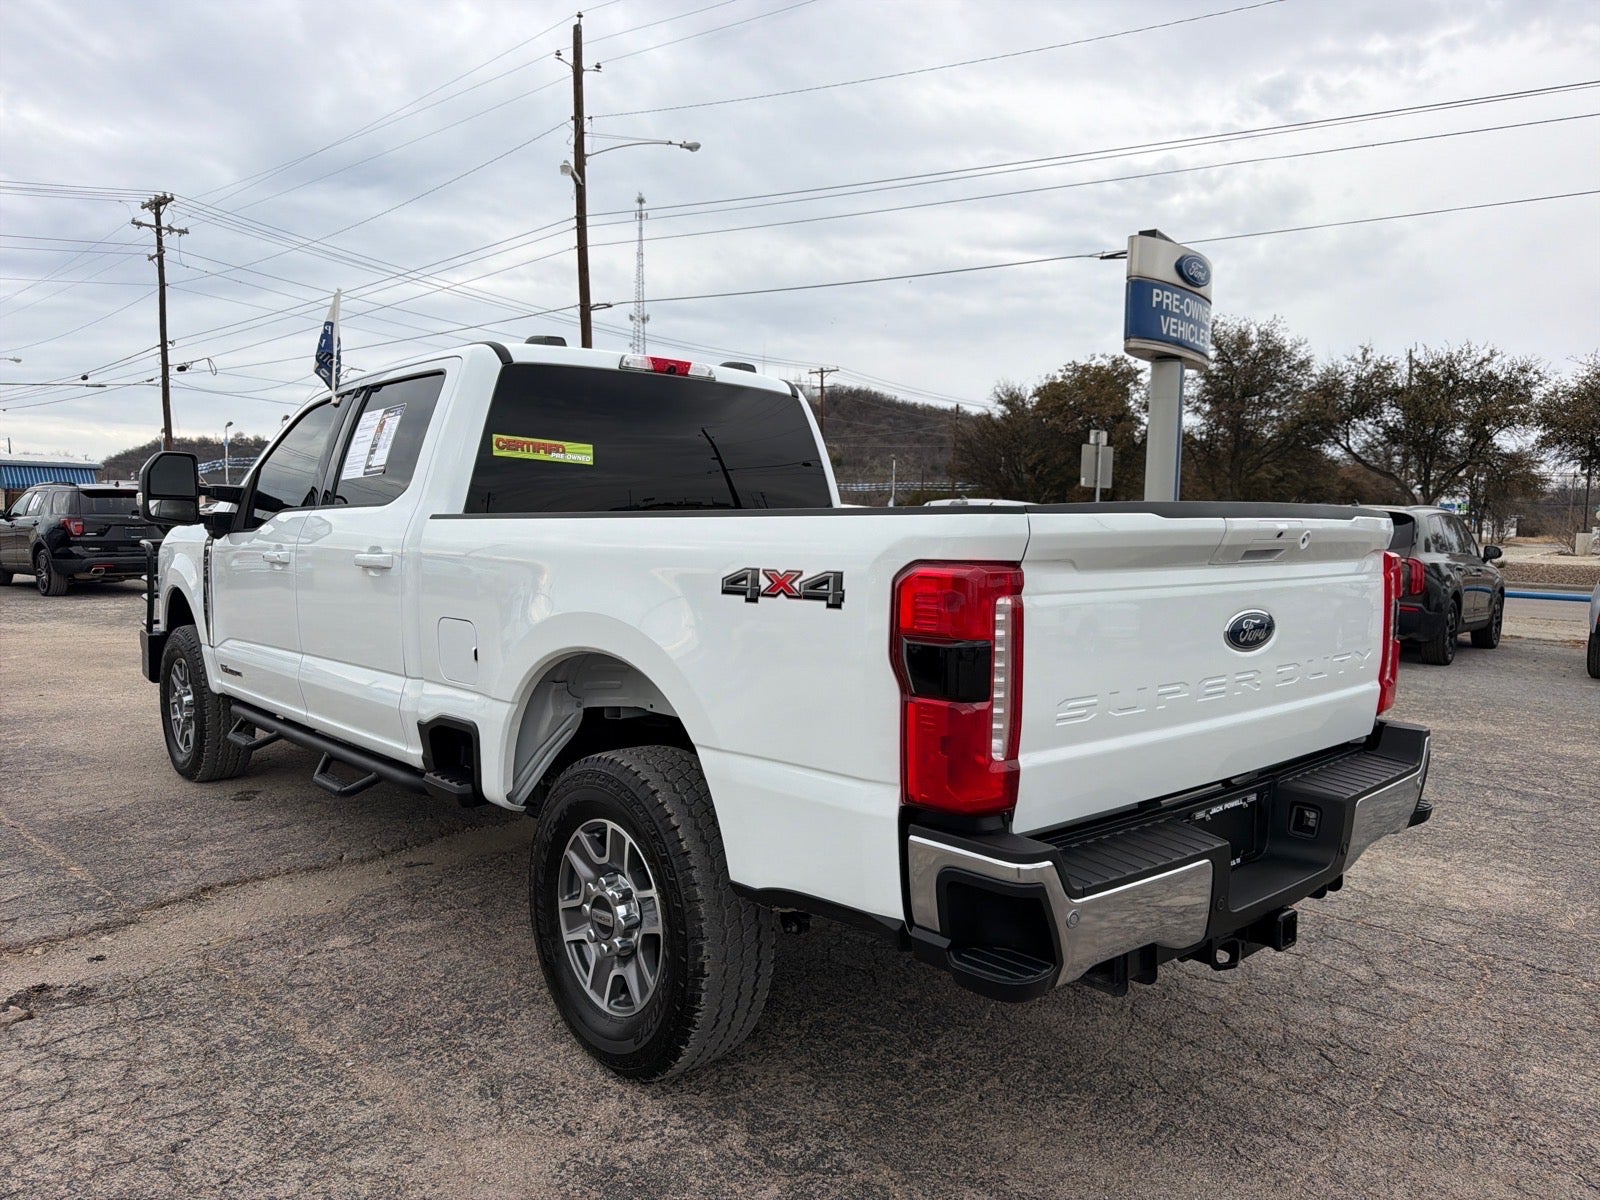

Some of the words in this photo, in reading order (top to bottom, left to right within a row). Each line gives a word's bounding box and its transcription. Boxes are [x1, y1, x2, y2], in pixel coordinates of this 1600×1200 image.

[1152, 289, 1211, 325] PRE-OWNE
[495, 437, 566, 455] CERTIFIED
[1239, 618, 1268, 643] Ford
[1055, 668, 1263, 727] SUPER
[1274, 648, 1372, 688] DUTY
[1209, 805, 1224, 815] JACK
